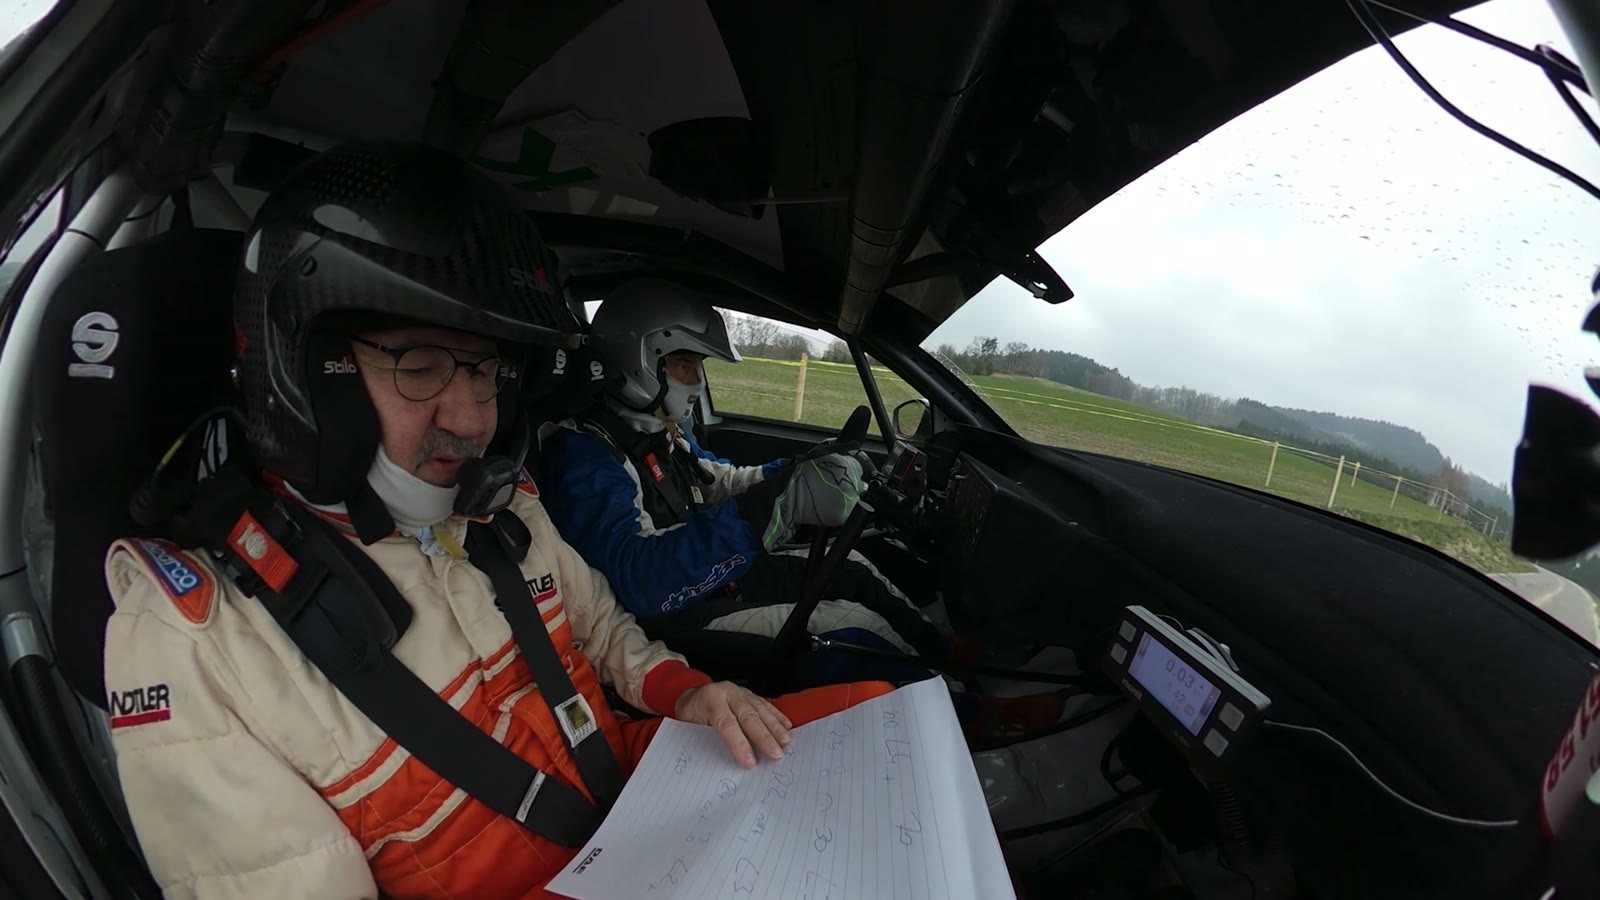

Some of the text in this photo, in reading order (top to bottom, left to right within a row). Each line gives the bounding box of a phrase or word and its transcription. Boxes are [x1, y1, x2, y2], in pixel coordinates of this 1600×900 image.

[323, 353, 358, 375] Stilo
[660, 553, 747, 613] alpinestars
[108, 684, 171, 715] NDTLER
